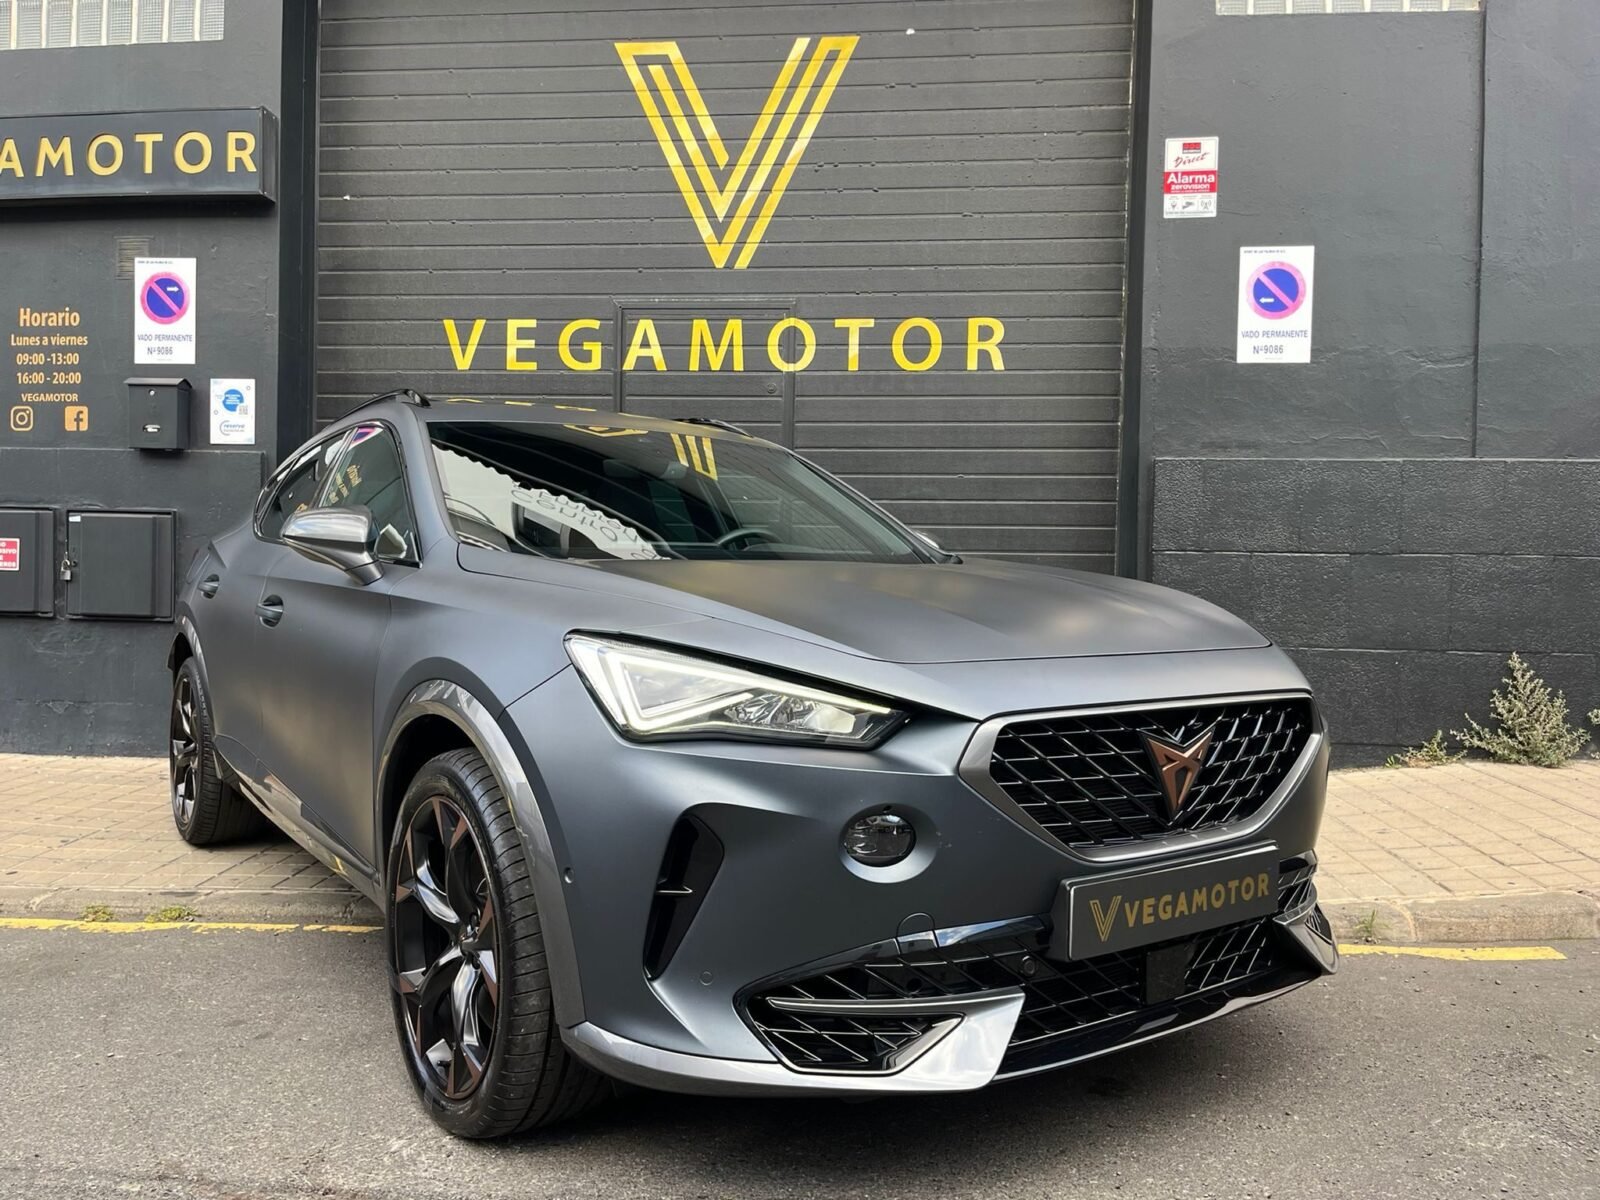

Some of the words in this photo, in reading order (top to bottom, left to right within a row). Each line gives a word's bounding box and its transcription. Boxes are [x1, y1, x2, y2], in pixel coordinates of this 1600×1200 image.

[0, 131, 257, 178] AMOTOR
[1167, 172, 1215, 184] Alarma
[19, 307, 80, 327] Horario
[11, 334, 40, 346] Lunes
[42, 337, 49, 346] a
[50, 333, 88, 346] viernes
[137, 334, 153, 342] VADO
[154, 334, 193, 342] PERMANENTE
[1241, 330, 1260, 338] VADO
[1262, 329, 1308, 338] PERMANENTE
[443, 317, 1005, 372] VEGAMOTOR
[16, 353, 45, 365] 09:00
[16, 372, 44, 384] 16:00
[52, 372, 81, 384] 20:00
[21, 393, 79, 402] VEGAMOTOR
[1124, 872, 1270, 928] VEGAMOTOR
